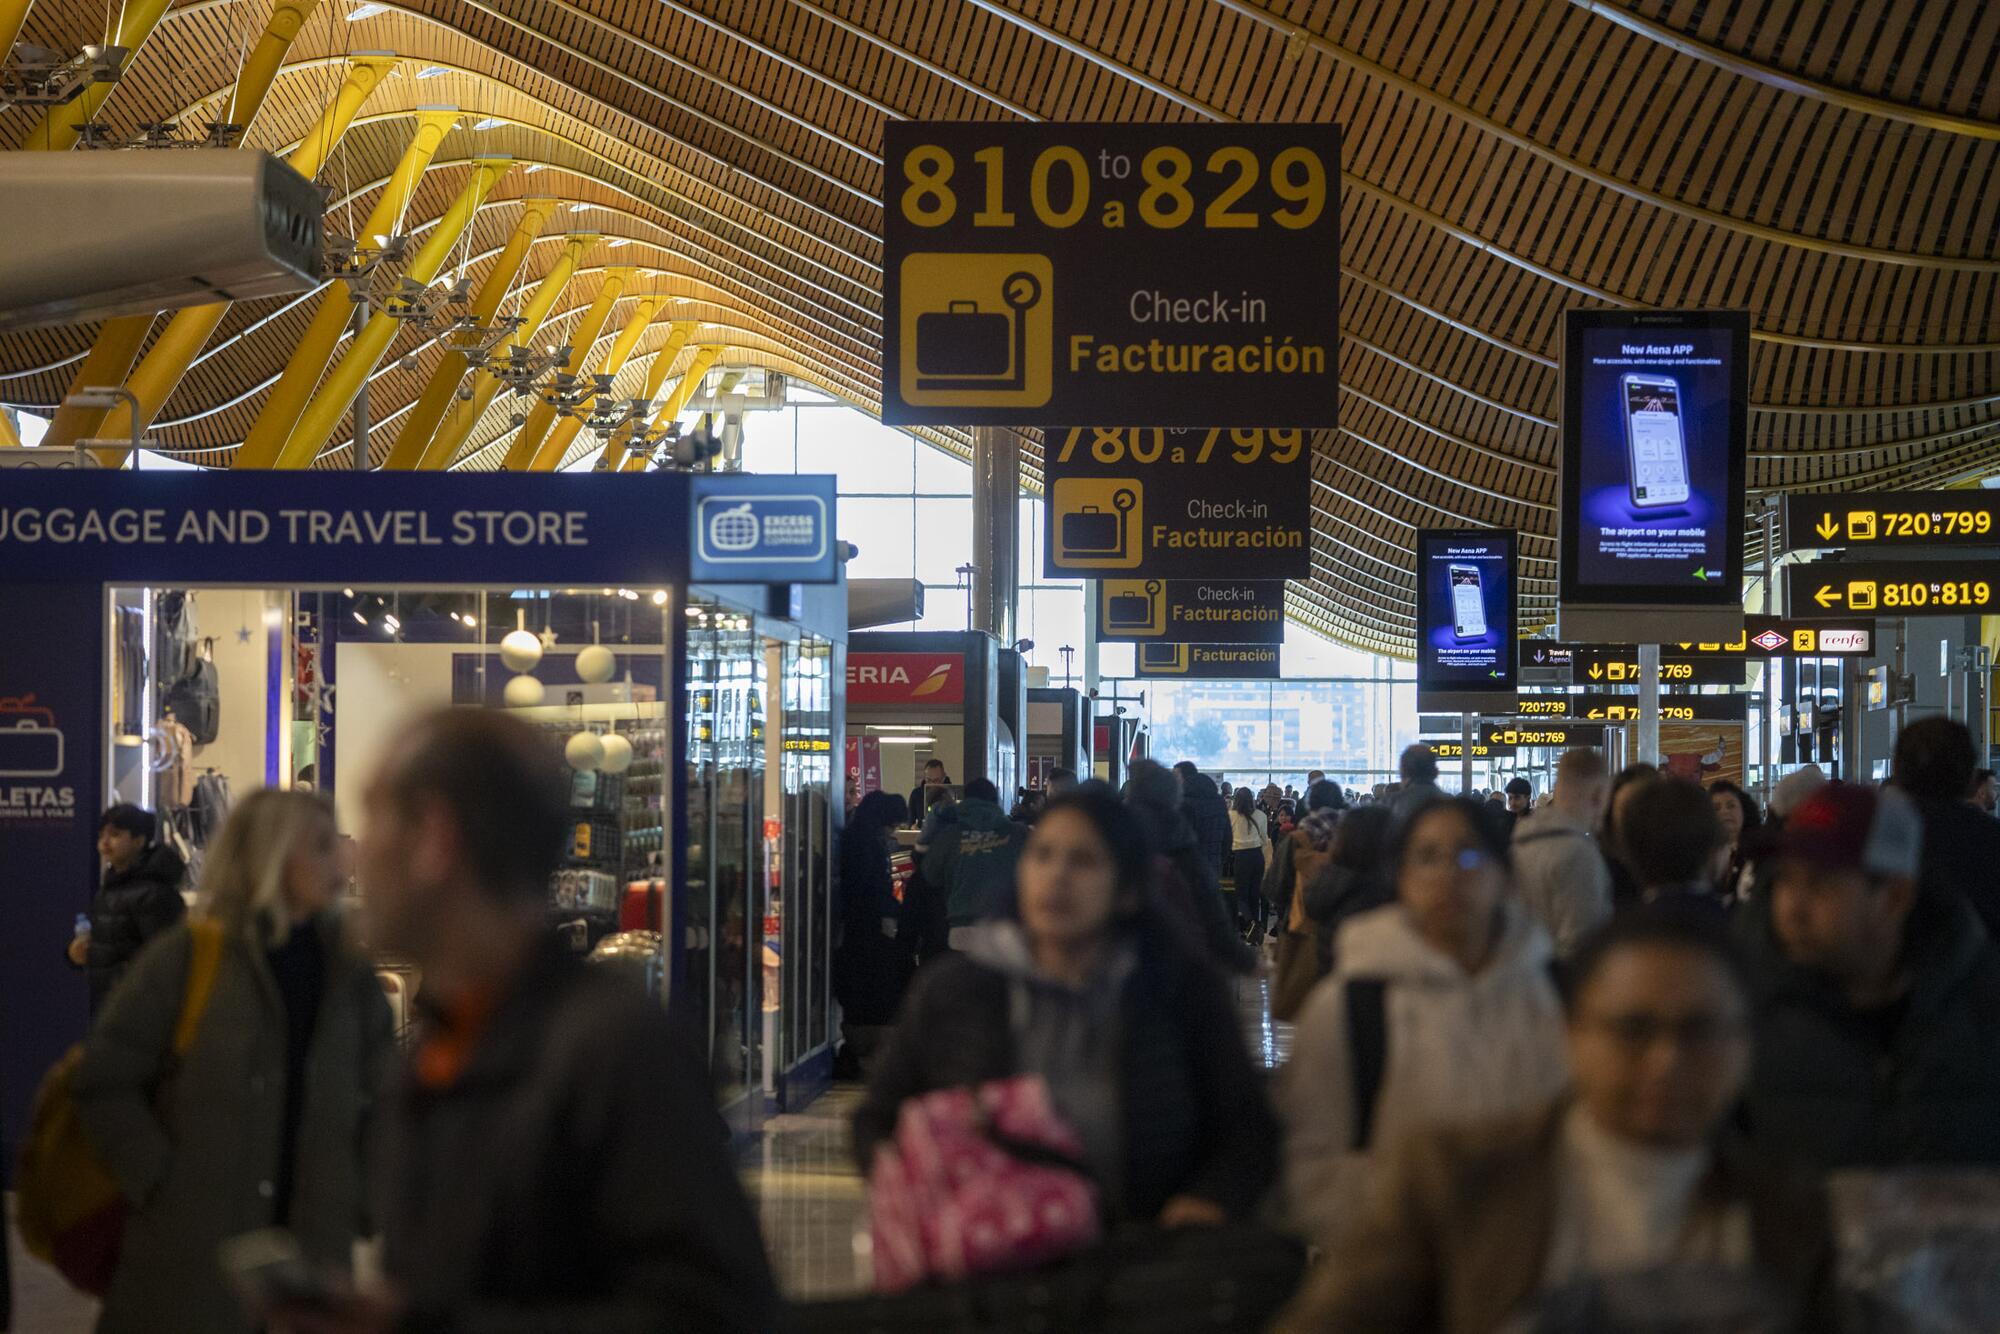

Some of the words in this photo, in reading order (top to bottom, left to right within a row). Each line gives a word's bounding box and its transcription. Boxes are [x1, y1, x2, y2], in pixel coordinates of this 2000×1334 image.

[1099, 148, 1131, 179] to
[902, 145, 1090, 228] 810
[1138, 146, 1326, 229] 829
[1102, 201, 1125, 228] a
[1130, 290, 1266, 323] Check-in
[1070, 334, 1325, 373] Facturación
[1622, 345, 1645, 354] New
[1645, 345, 1671, 354] Aena
[1672, 345, 1694, 354] APP
[1057, 427, 1165, 464] 780
[1171, 447, 1185, 463] a
[1196, 427, 1303, 464] 799
[1187, 499, 1268, 519] Check-in
[1932, 512, 1941, 522] to
[175, 510, 270, 544] AND
[279, 511, 442, 545] TRAVEL
[452, 511, 589, 545] STORE
[1882, 512, 1931, 536] 720
[1933, 524, 1941, 534] a
[1943, 511, 1991, 535] 799
[1152, 525, 1302, 548] Facturación
[1600, 528, 1616, 536] The
[1617, 528, 1645, 537] airport
[1658, 529, 1677, 538] your
[1678, 528, 1706, 537] mobile
[1197, 586, 1255, 601] Check-in
[1883, 583, 1928, 606] 810
[1930, 583, 1940, 593] to
[1941, 582, 1990, 605] 819
[1932, 595, 1939, 604] a
[1172, 605, 1278, 621] Facturación
[1825, 633, 1864, 648] renfe
[1193, 648, 1276, 662] Facturación
[1665, 664, 1692, 678] 769
[1519, 702, 1540, 712] 720
[1545, 702, 1566, 712] 739
[1664, 708, 1693, 720] 799
[1519, 732, 1540, 743] 750
[1545, 732, 1565, 743] 769
[1451, 746, 1462, 755] 72
[1472, 746, 1488, 755] 739
